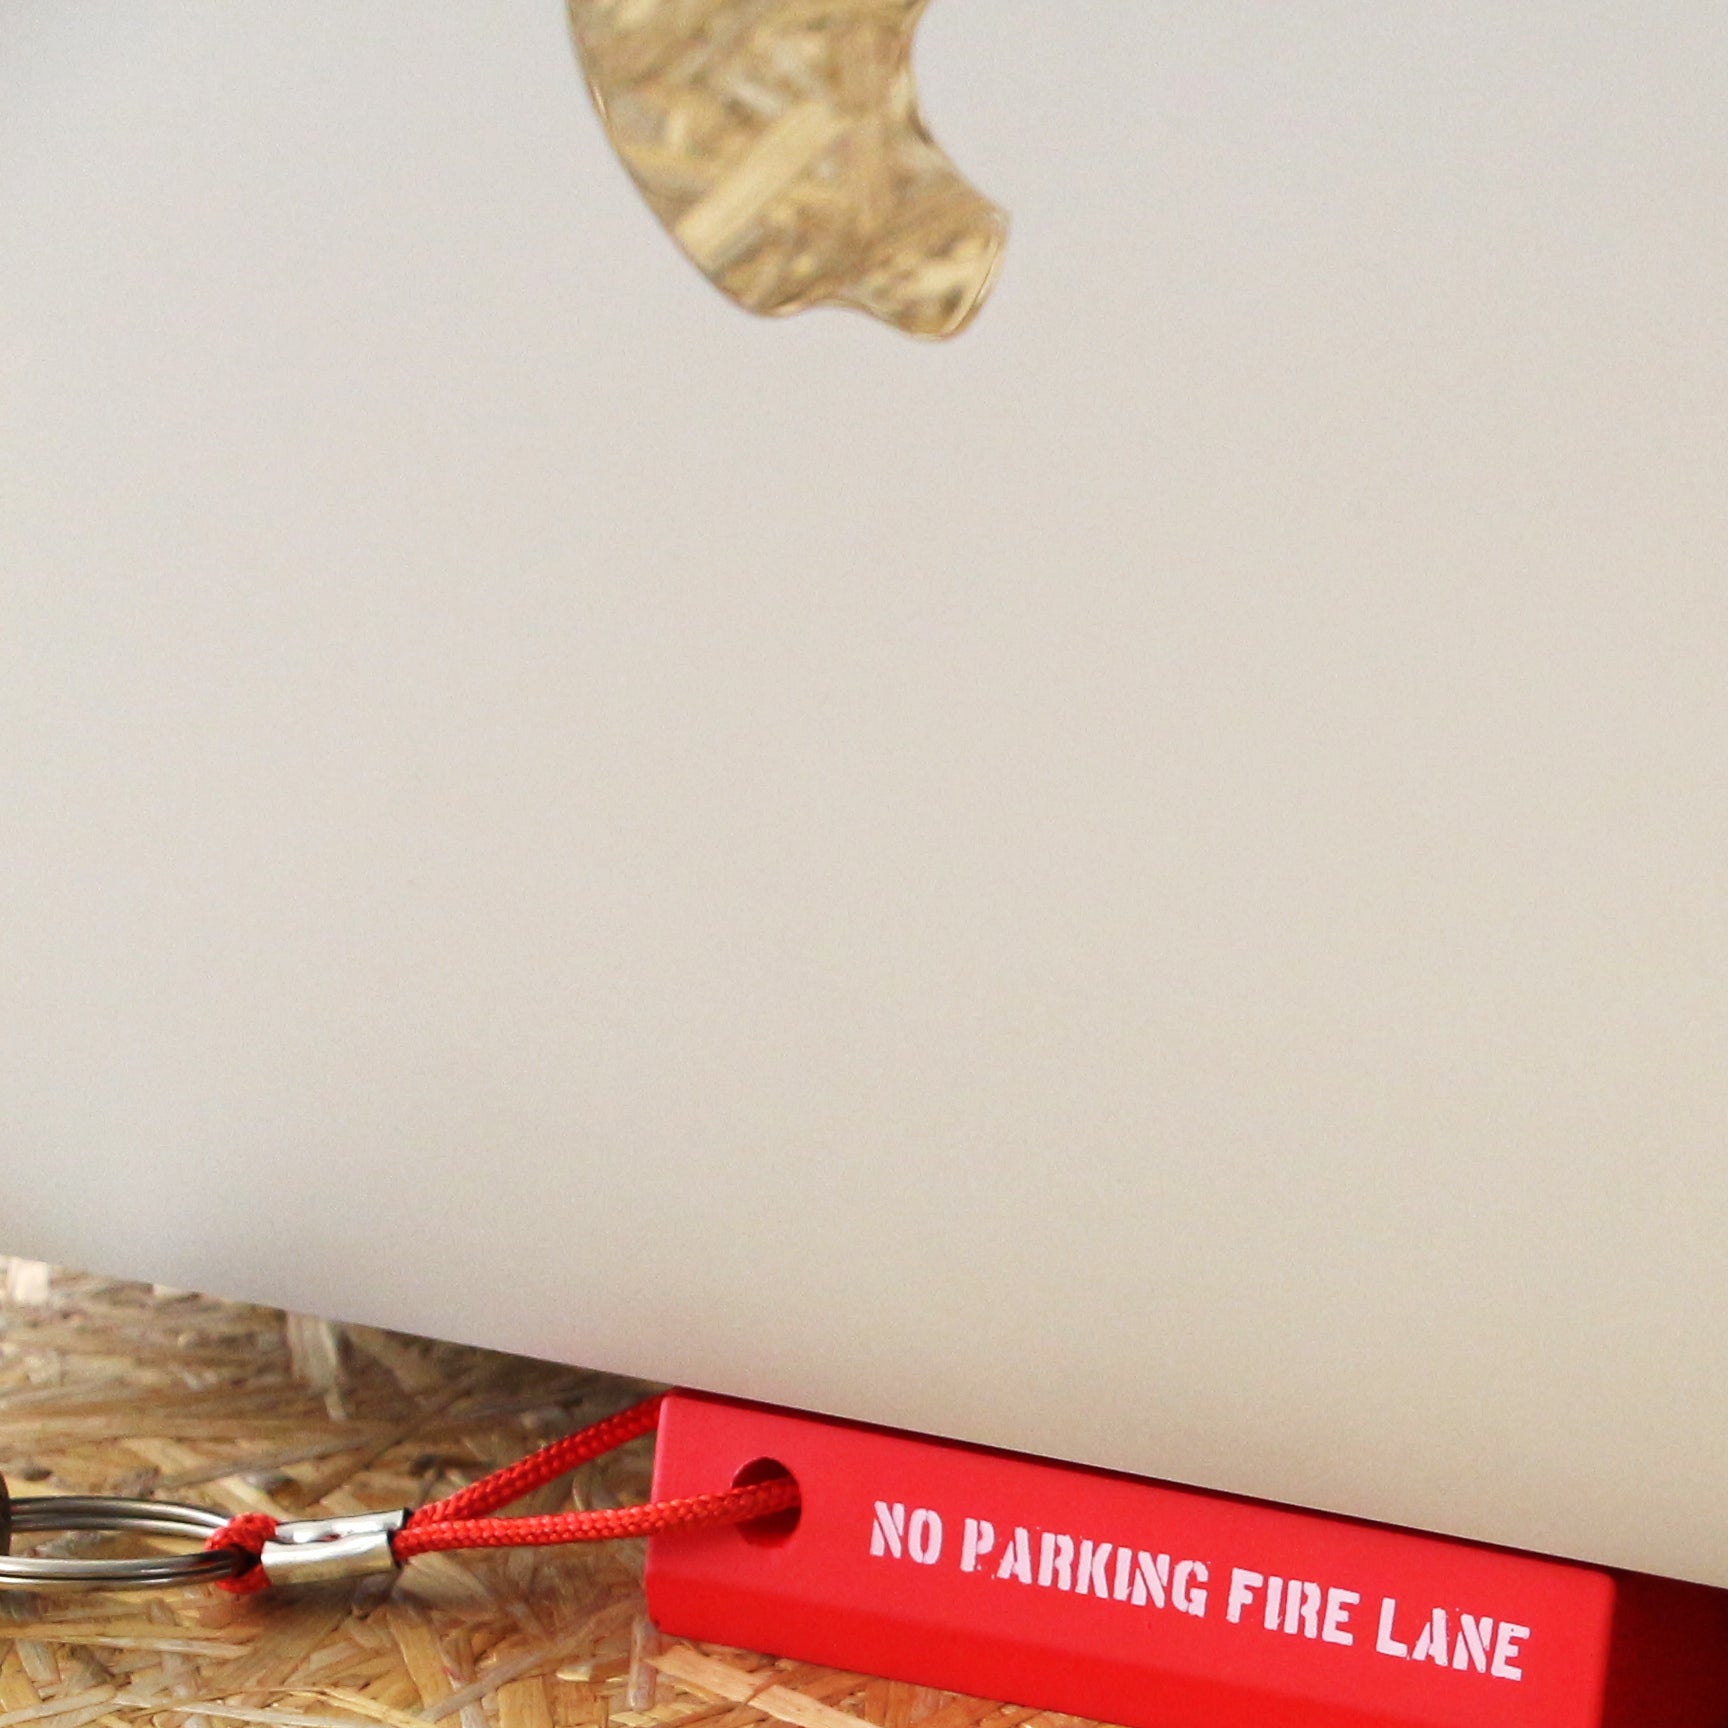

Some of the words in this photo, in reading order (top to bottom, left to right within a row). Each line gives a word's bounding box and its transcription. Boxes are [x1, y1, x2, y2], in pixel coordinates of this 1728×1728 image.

[868, 1499, 944, 1566] NO
[959, 1516, 1210, 1619] PARKING
[1225, 1566, 1361, 1647] FIRE
[1375, 1597, 1531, 1682] LANE
